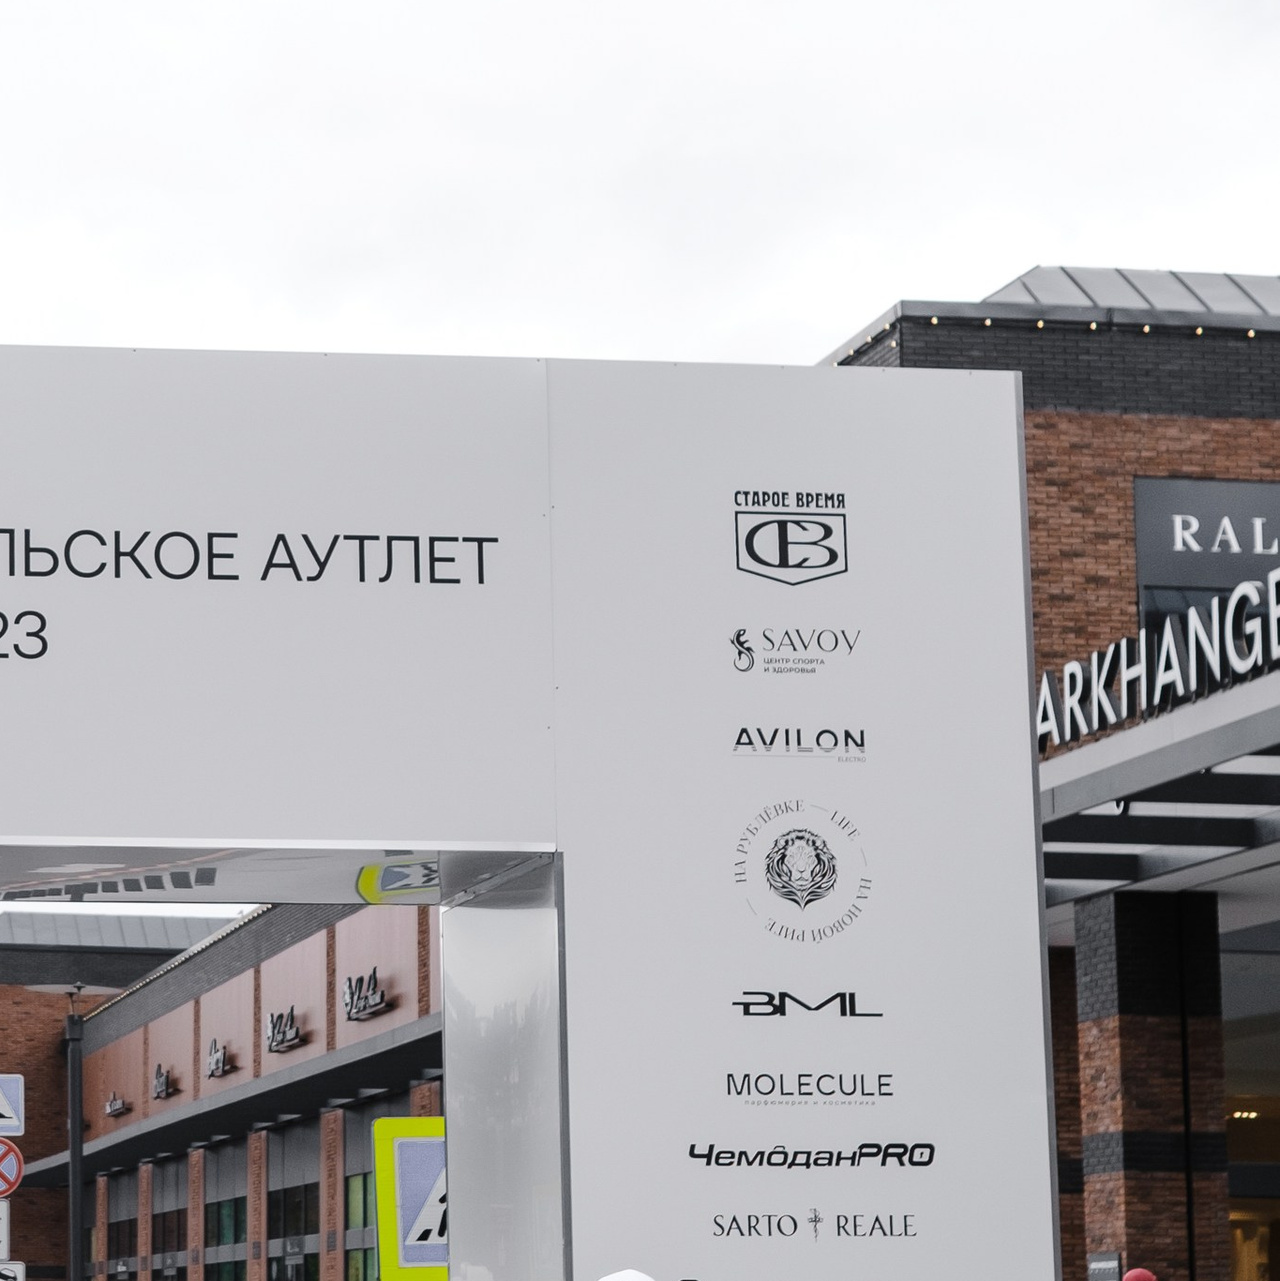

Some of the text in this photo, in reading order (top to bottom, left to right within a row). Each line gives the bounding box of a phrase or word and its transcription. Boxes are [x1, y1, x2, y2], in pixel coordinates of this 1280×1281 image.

[734, 490, 846, 509] СТАРОЕ ВРЕМЯ
[260, 533, 499, 585] АУТЛЕТ
[762, 628, 861, 655] SAVOY
[763, 657, 826, 666] ЦЕНТР СПОРТА
[732, 726, 866, 754] AVILON
[830, 810, 861, 842] LIFE
[734, 860, 747, 883] НА
[856, 877, 872, 900] НА
[727, 1073, 894, 1096] MOLECULE
[713, 1214, 918, 1238] SARTO REALE
